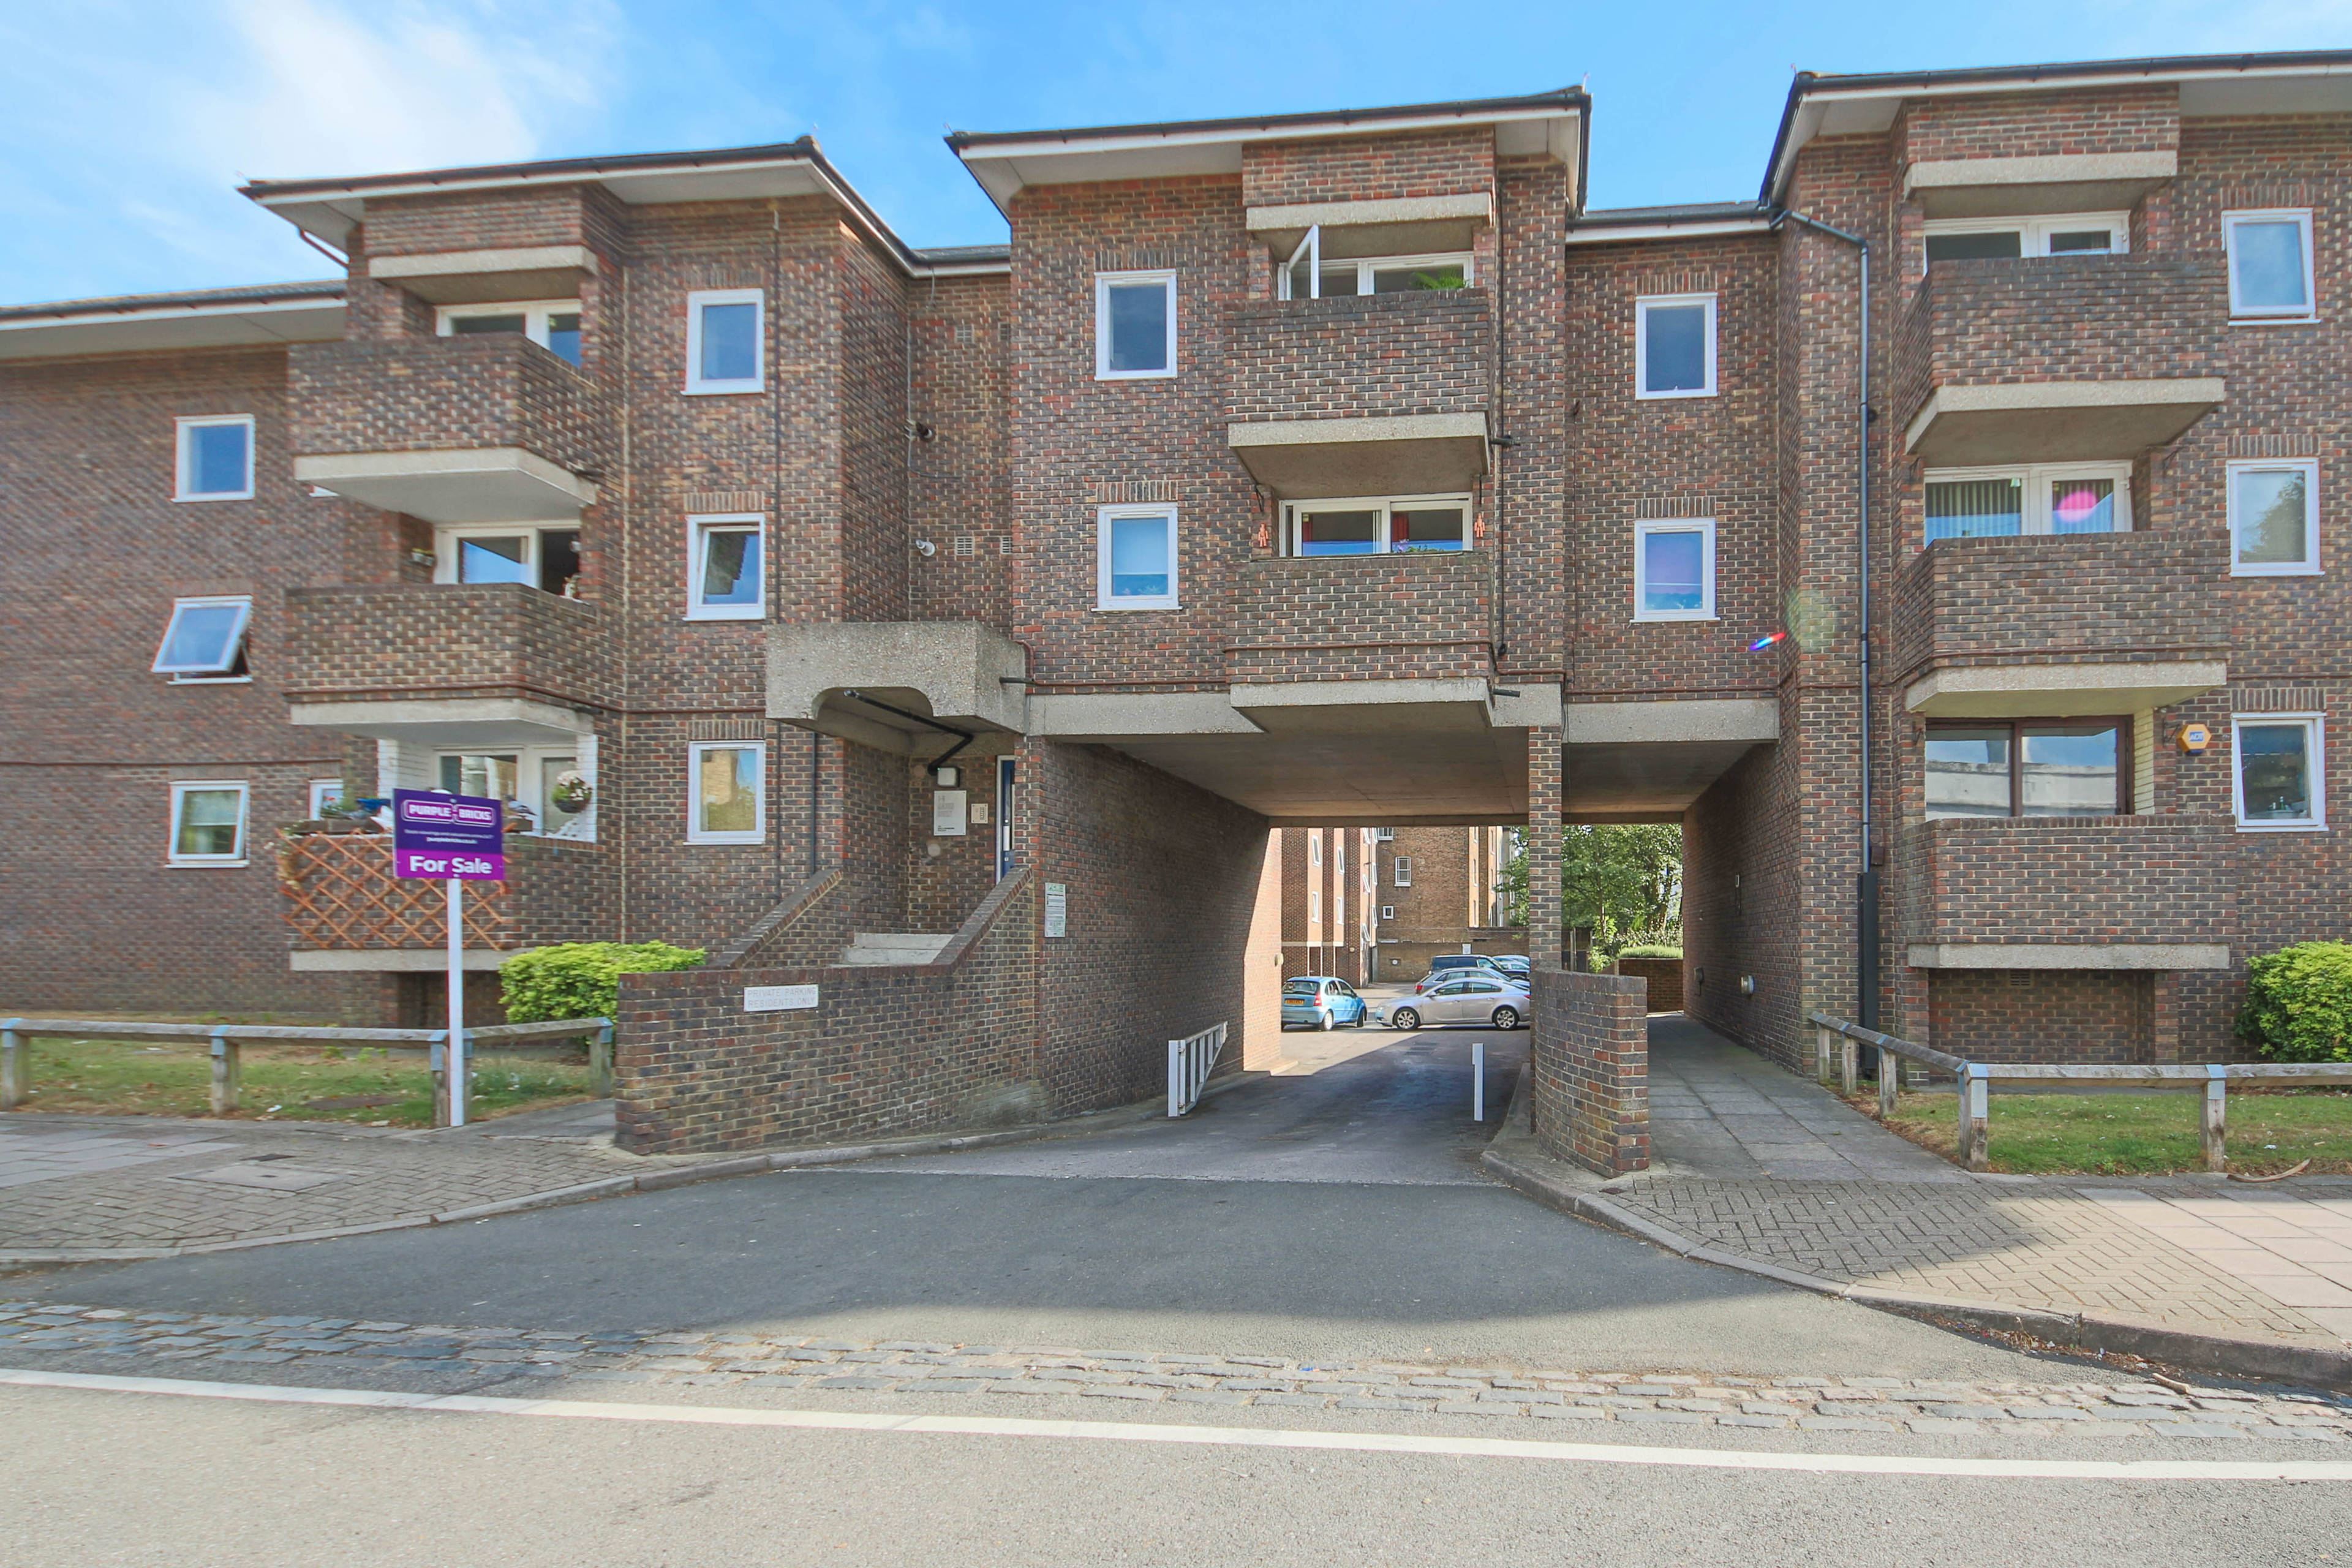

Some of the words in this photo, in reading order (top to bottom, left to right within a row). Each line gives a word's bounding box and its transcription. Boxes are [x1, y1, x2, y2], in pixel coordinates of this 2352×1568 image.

[409, 804, 451, 817] PURPLE
[459, 809, 492, 821] BRICKS
[409, 856, 448, 872] For
[451, 857, 492, 874] Sale
[747, 988, 780, 998] PRIVATE
[785, 987, 816, 996] PARKING
[748, 998, 794, 1008] RESIDENTS
[798, 997, 816, 1006] ONLY
